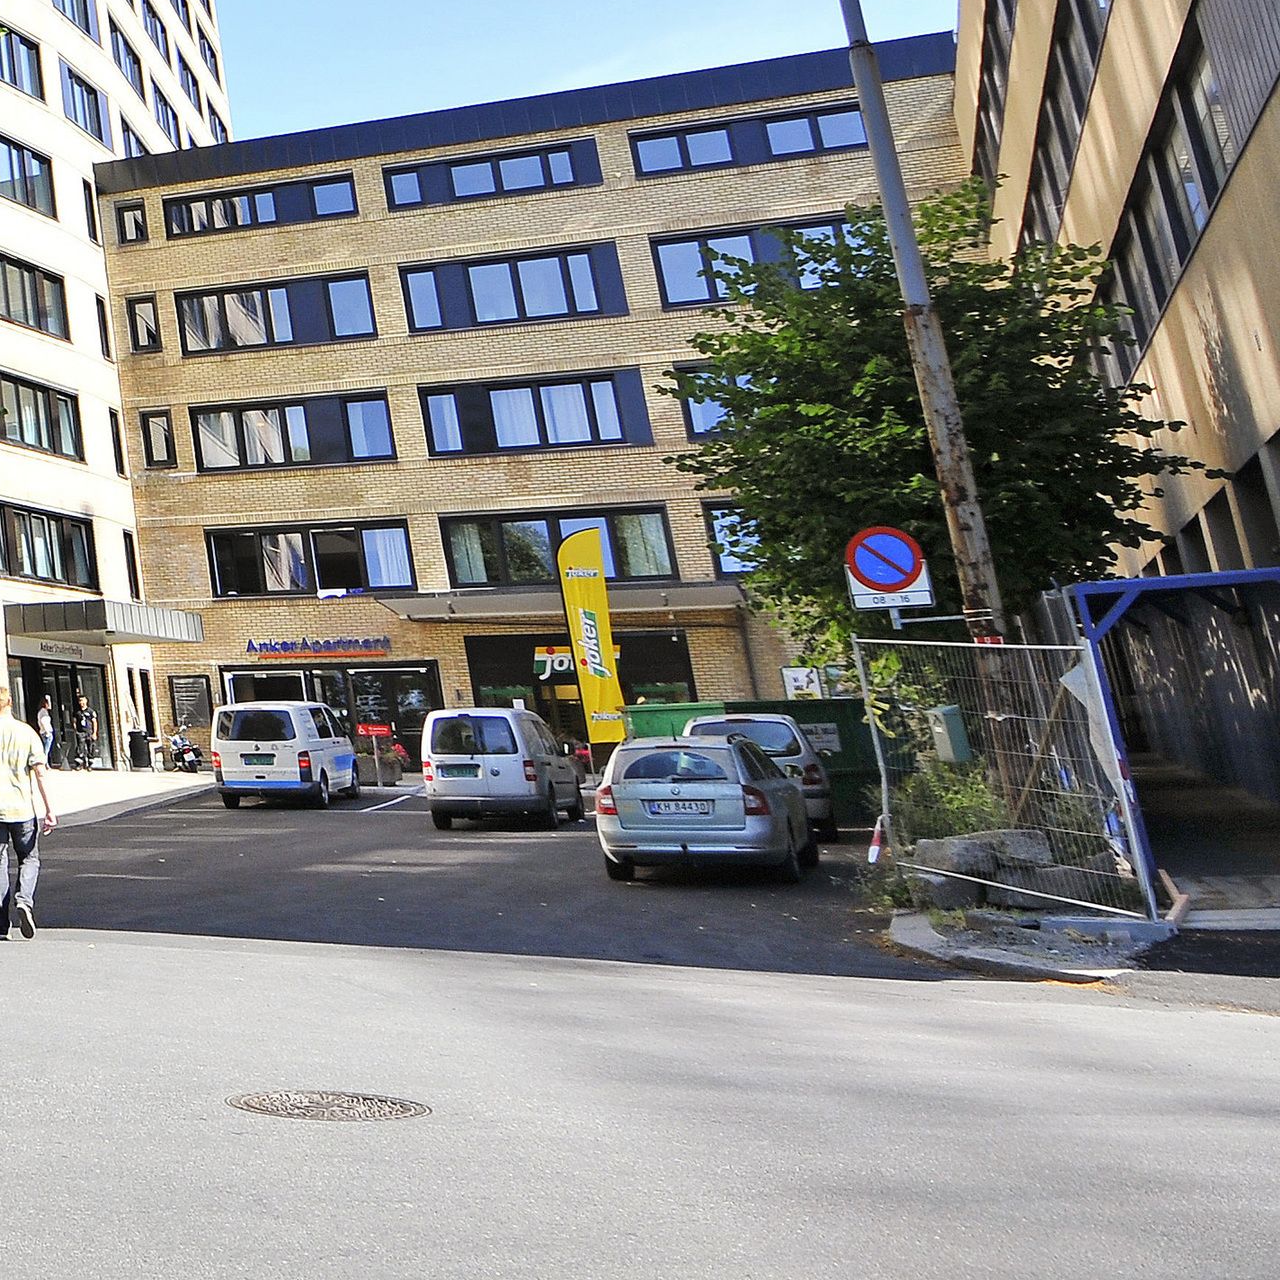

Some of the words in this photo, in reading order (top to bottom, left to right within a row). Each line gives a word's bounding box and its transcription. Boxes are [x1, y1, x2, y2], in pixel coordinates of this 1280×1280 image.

[872, 596, 886, 605] 08
[900, 594, 911, 604] 16
[577, 616, 612, 678] joker
[656, 802, 671, 811] KH
